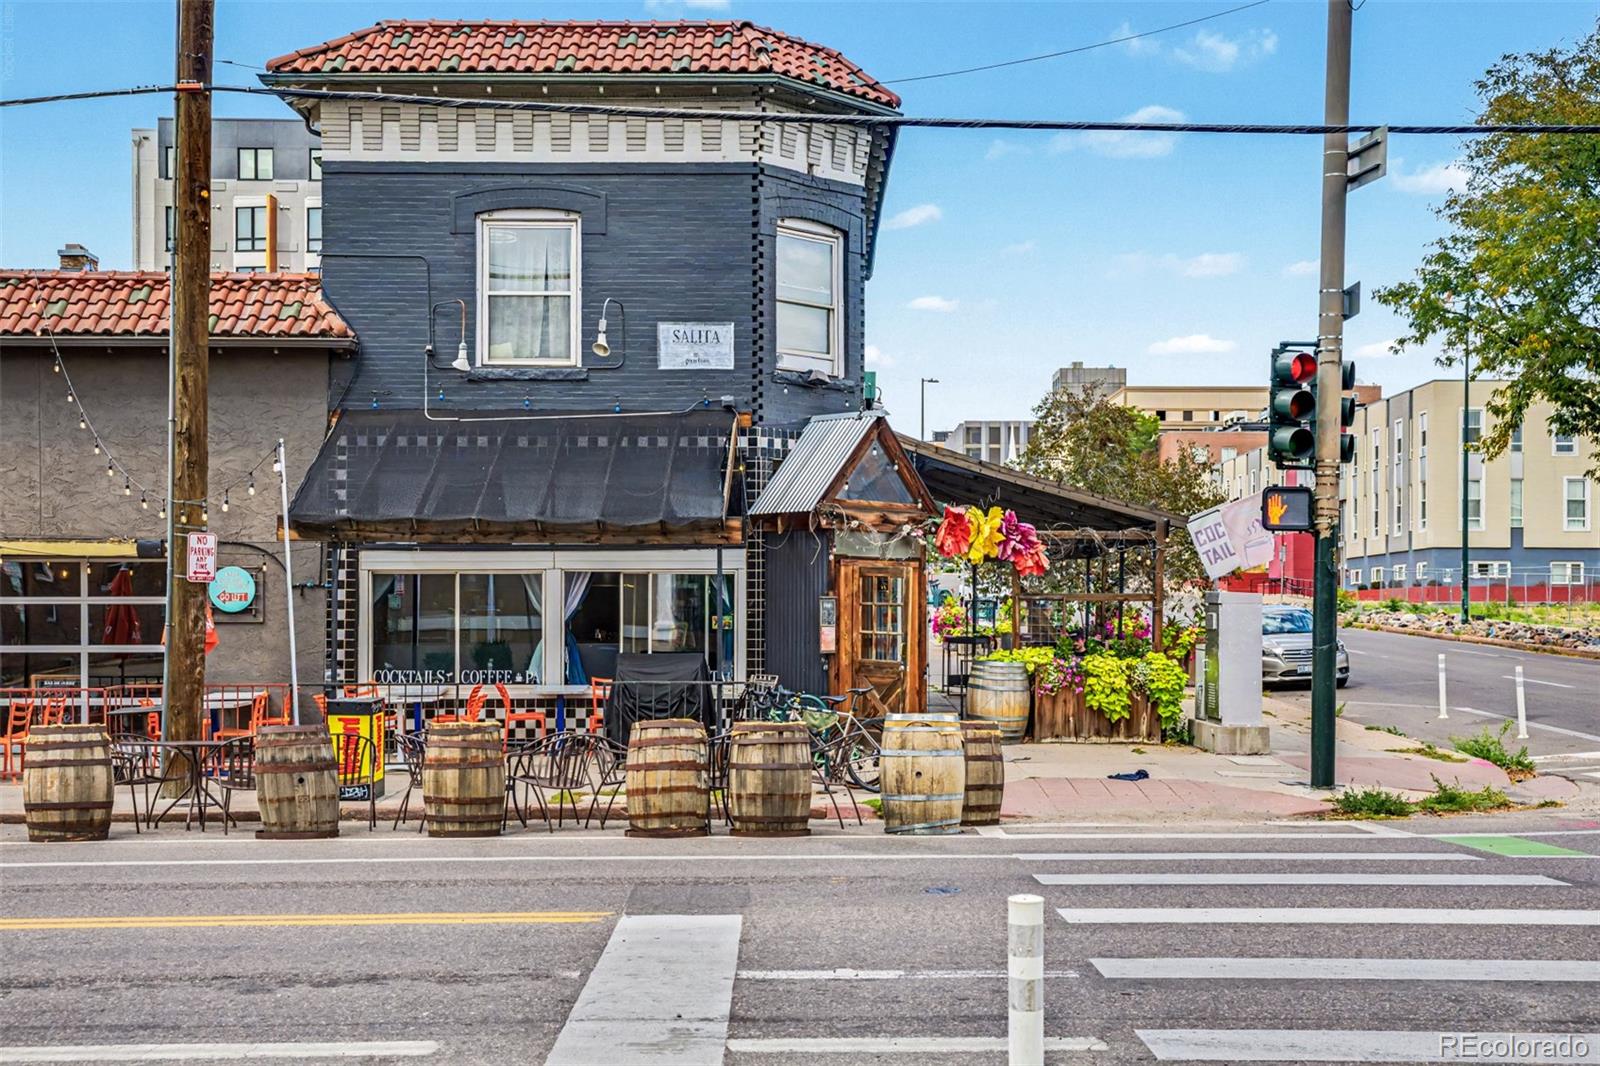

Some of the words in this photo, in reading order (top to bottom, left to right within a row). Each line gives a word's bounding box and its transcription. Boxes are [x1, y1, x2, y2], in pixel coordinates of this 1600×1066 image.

[672, 329, 720, 344] SALITA
[196, 536, 208, 545] NO
[1194, 522, 1226, 547] COC
[191, 547, 214, 556] PARKING
[1202, 542, 1236, 566] TAIL
[219, 593, 230, 601] GO
[373, 669, 445, 684] COCKTAILS
[461, 669, 513, 684] COFFEE
